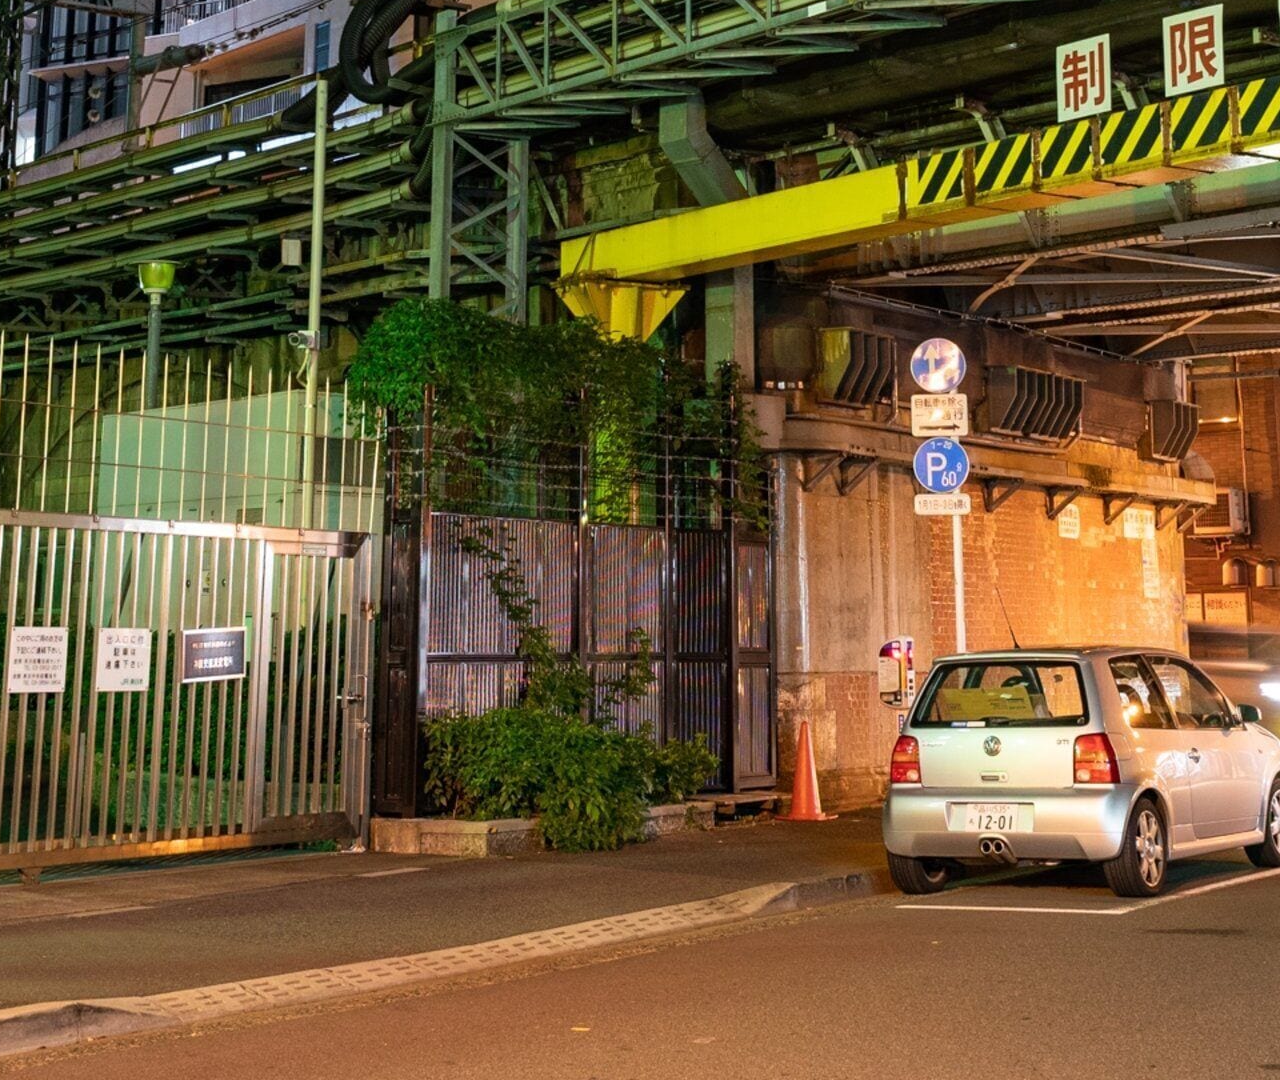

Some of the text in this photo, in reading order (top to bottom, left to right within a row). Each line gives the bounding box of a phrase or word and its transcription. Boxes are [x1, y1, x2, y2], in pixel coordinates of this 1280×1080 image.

[915, 397, 964, 408] 自転車を除く
[926, 452, 947, 487] P
[978, 815, 1013, 830] 12-01
